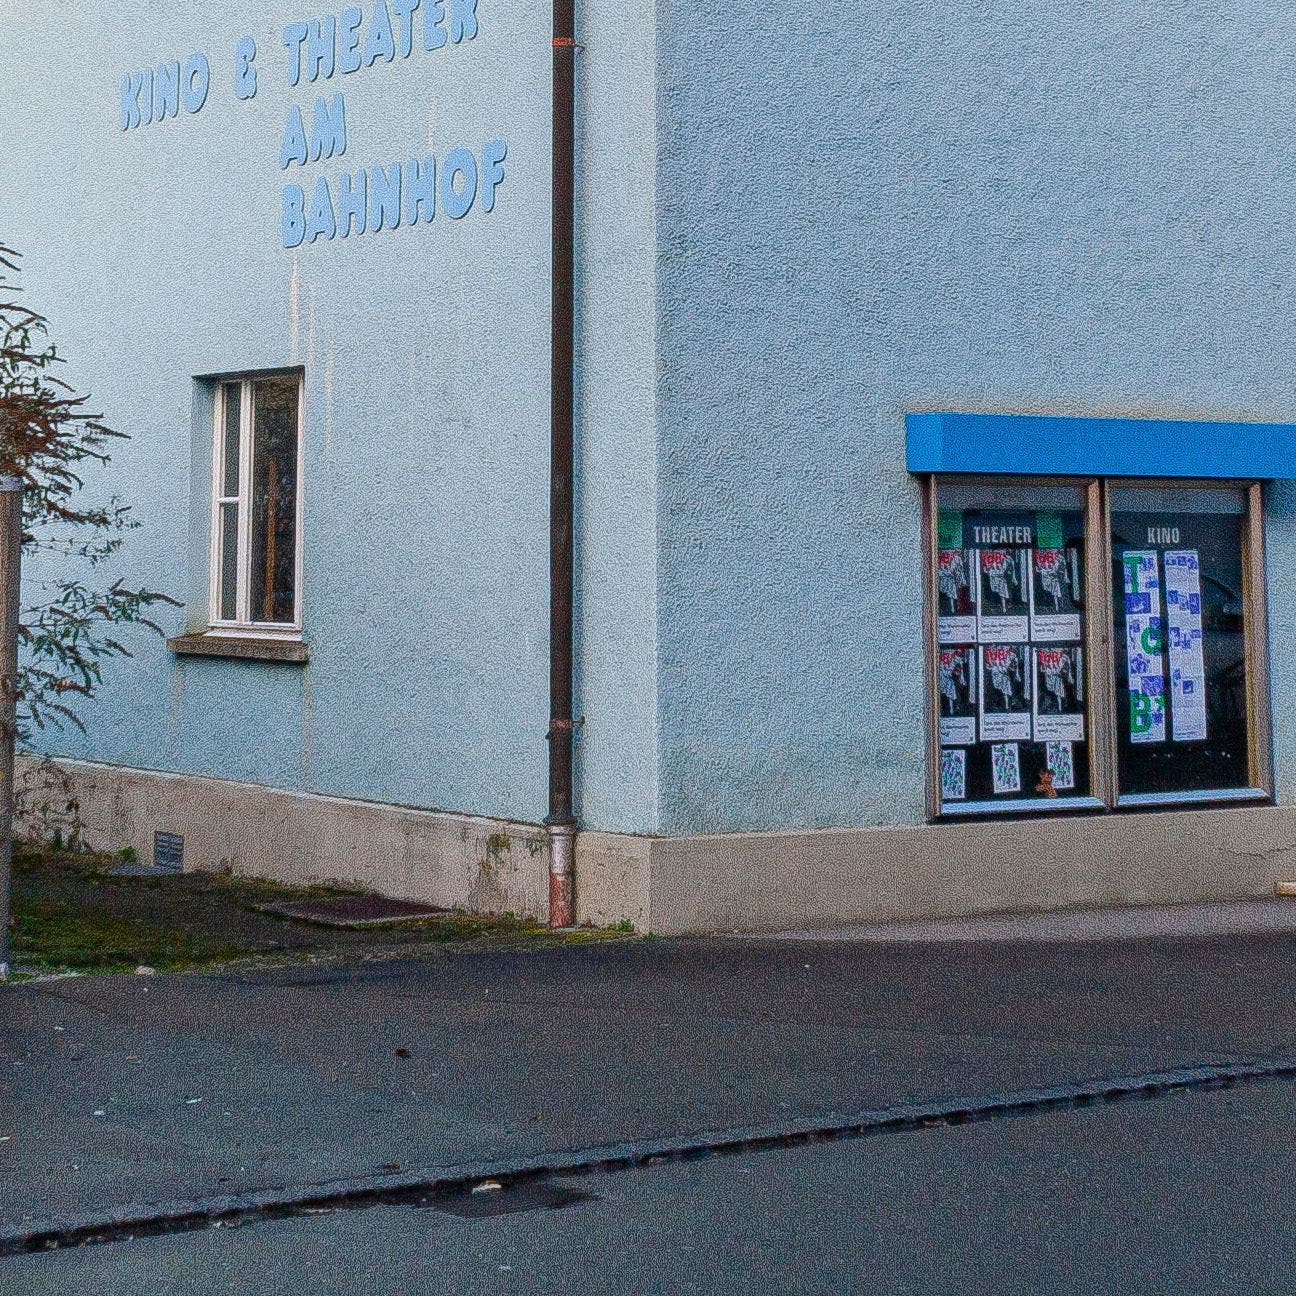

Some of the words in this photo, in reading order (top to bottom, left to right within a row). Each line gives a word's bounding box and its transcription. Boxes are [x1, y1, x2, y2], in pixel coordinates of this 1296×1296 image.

[118, 52, 210, 131] KINO
[280, 92, 347, 169] AM
[281, 139, 507, 249] BAHNHOF
[973, 526, 1031, 544] THEATER
[1147, 527, 1180, 544] KINO
